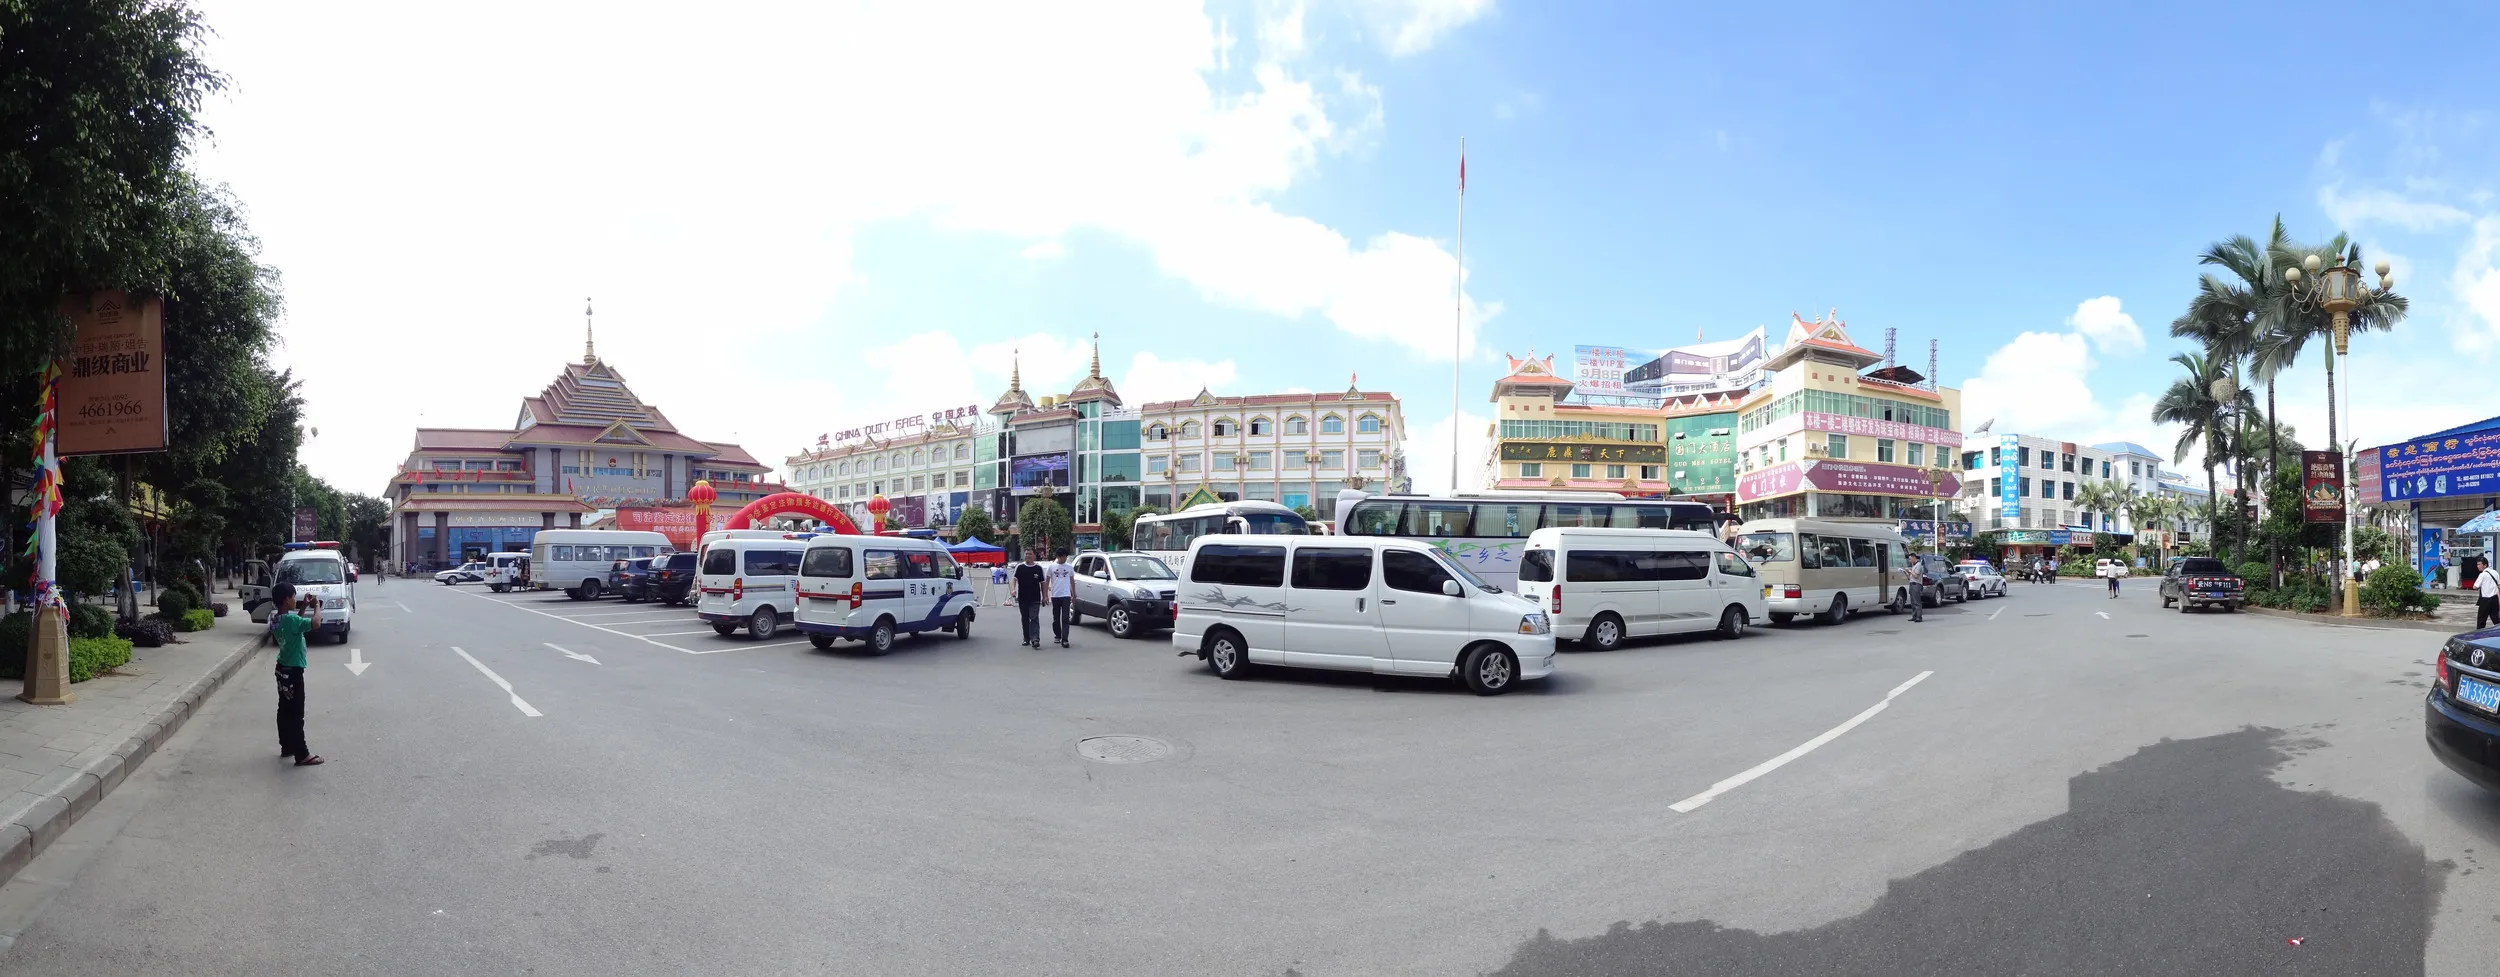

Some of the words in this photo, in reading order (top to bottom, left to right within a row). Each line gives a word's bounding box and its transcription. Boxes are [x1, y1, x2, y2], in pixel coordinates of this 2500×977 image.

[1581, 368, 1621, 380] 9月8日
[79, 399, 142, 418] 4661966
[835, 428, 861, 441] CHINA
[865, 421, 891, 435] DUTY
[896, 415, 923, 429] FREE
[932, 404, 978, 420] 中国免税
[910, 583, 928, 596] 司法
